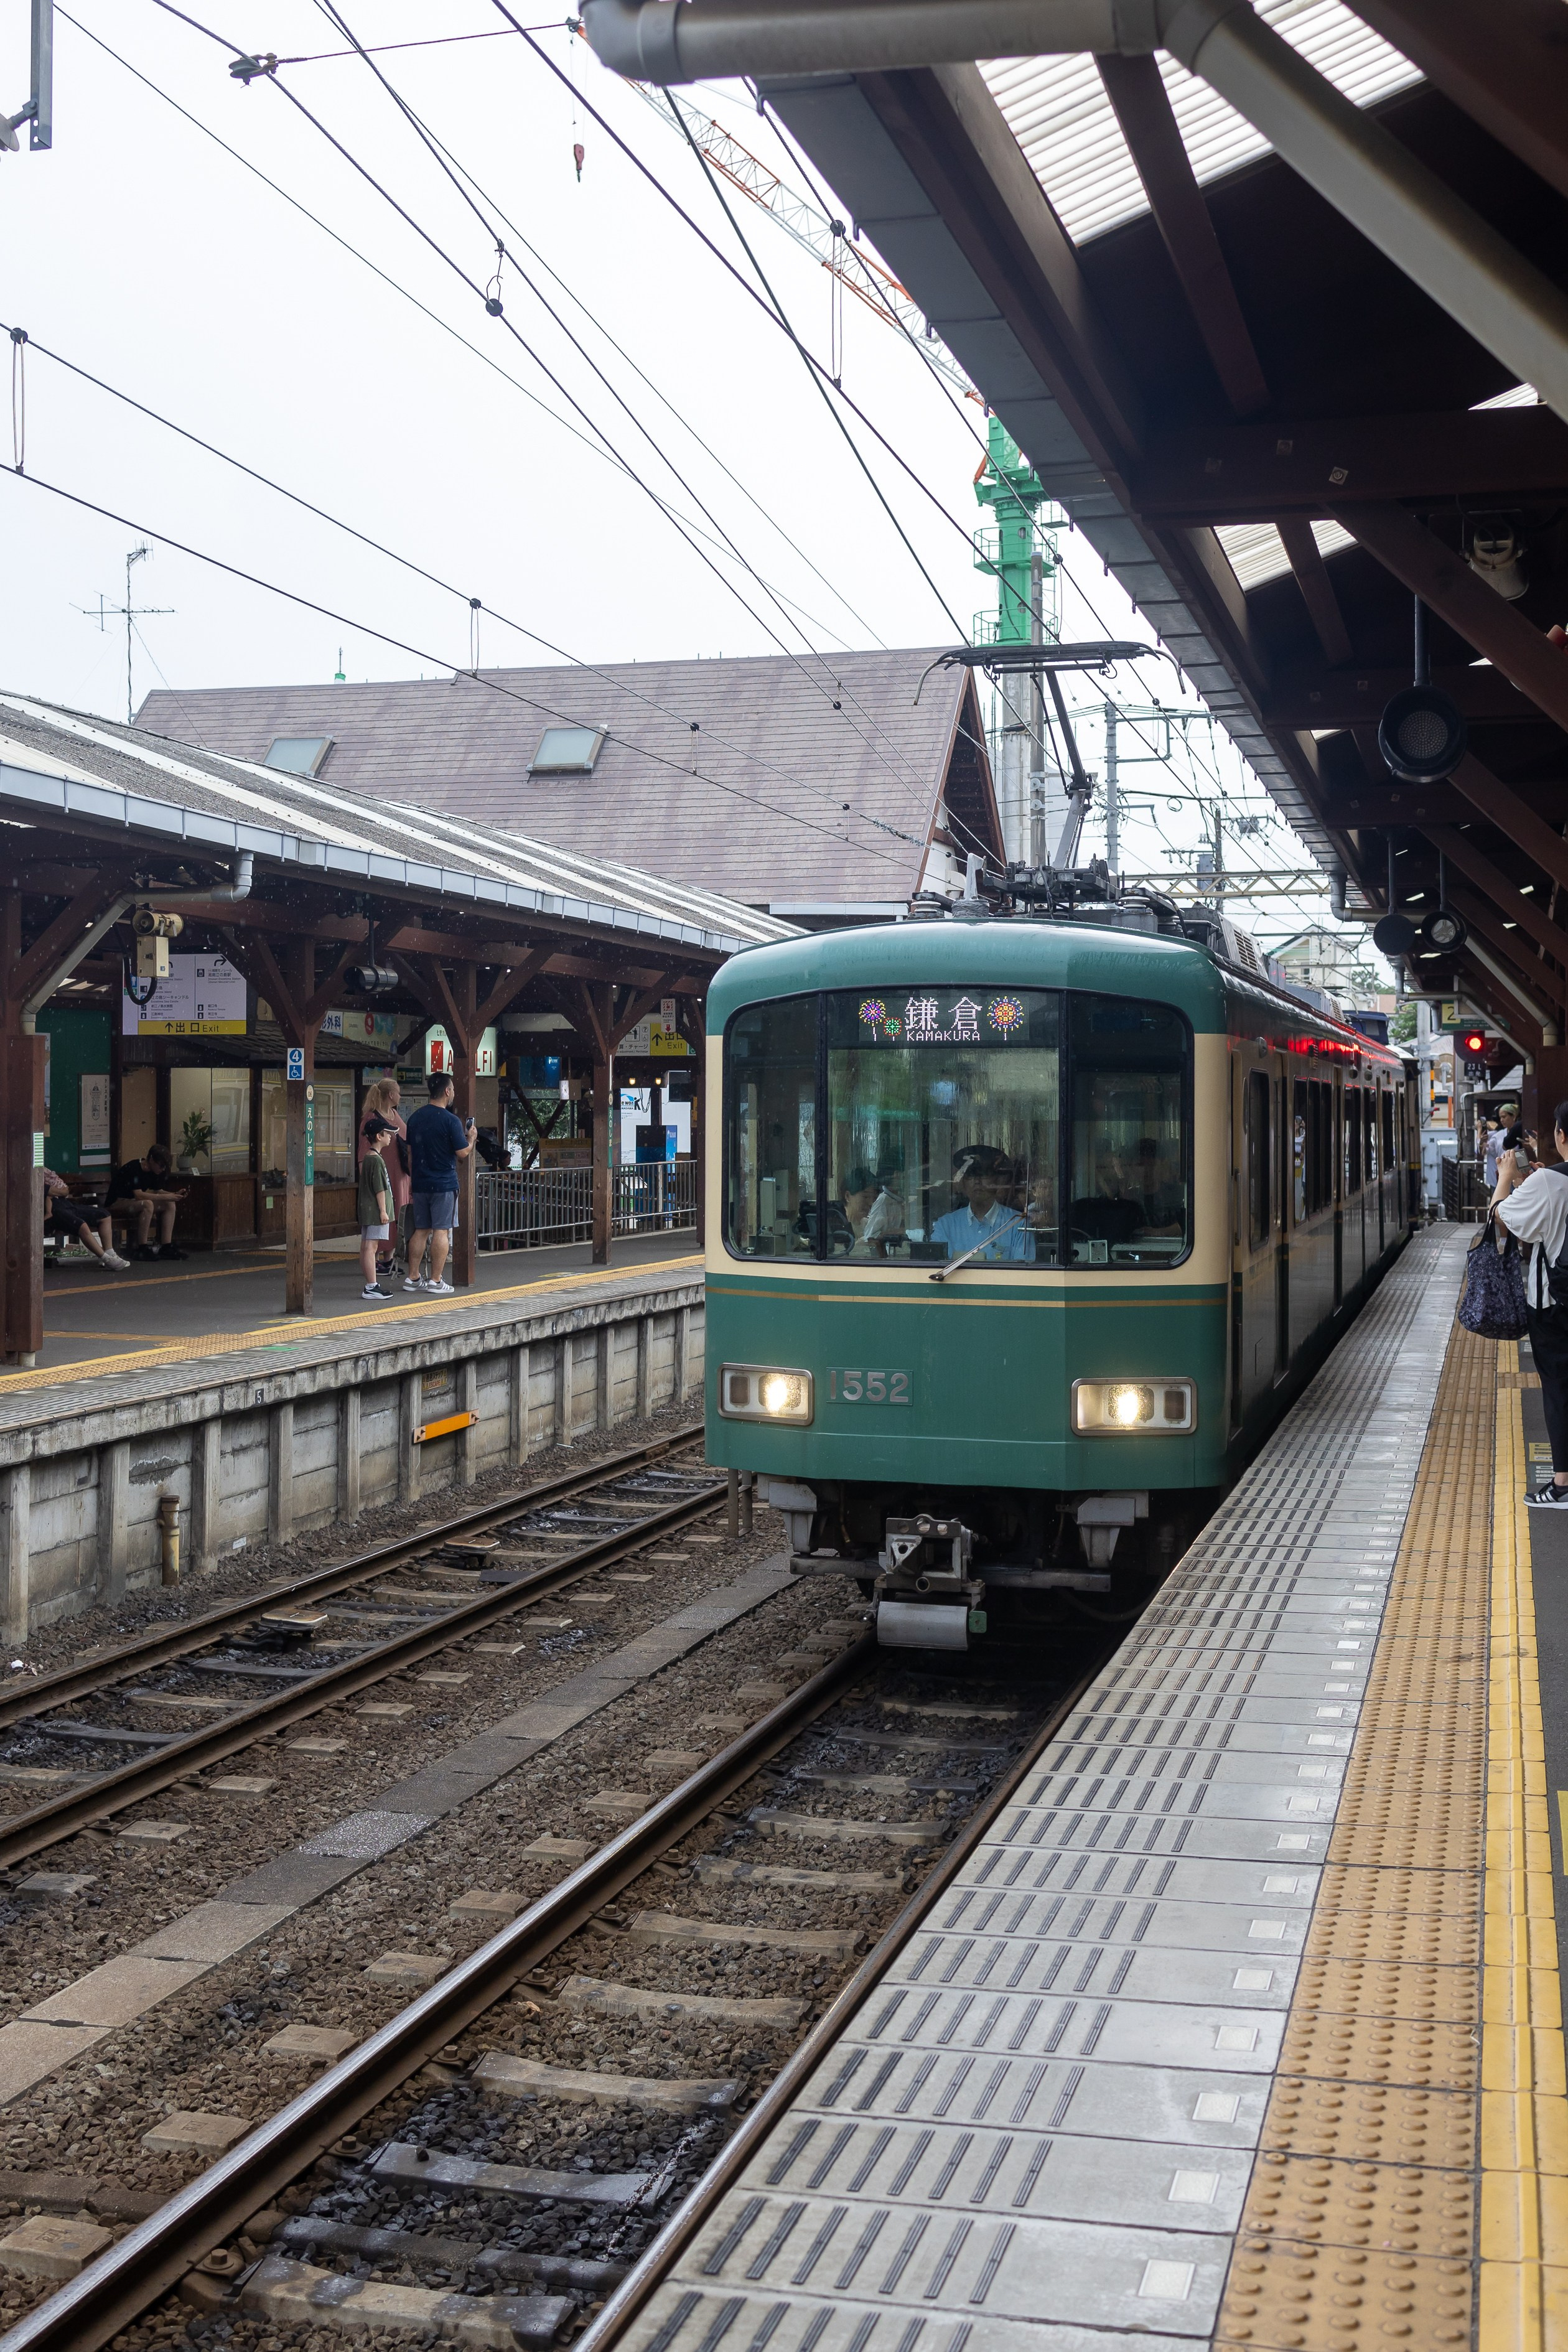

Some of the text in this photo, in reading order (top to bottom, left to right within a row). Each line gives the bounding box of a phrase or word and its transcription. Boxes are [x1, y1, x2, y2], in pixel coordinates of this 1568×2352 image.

[905, 997, 982, 1030] 鎌倉
[1447, 1006, 1456, 1020] 2
[175, 1022, 199, 1033] 出口
[202, 1024, 219, 1032] Exit
[907, 1030, 980, 1042] KAMAKURA
[292, 1050, 299, 1062] 4
[830, 1371, 908, 1402] 1552
[257, 1390, 261, 1404] 5
